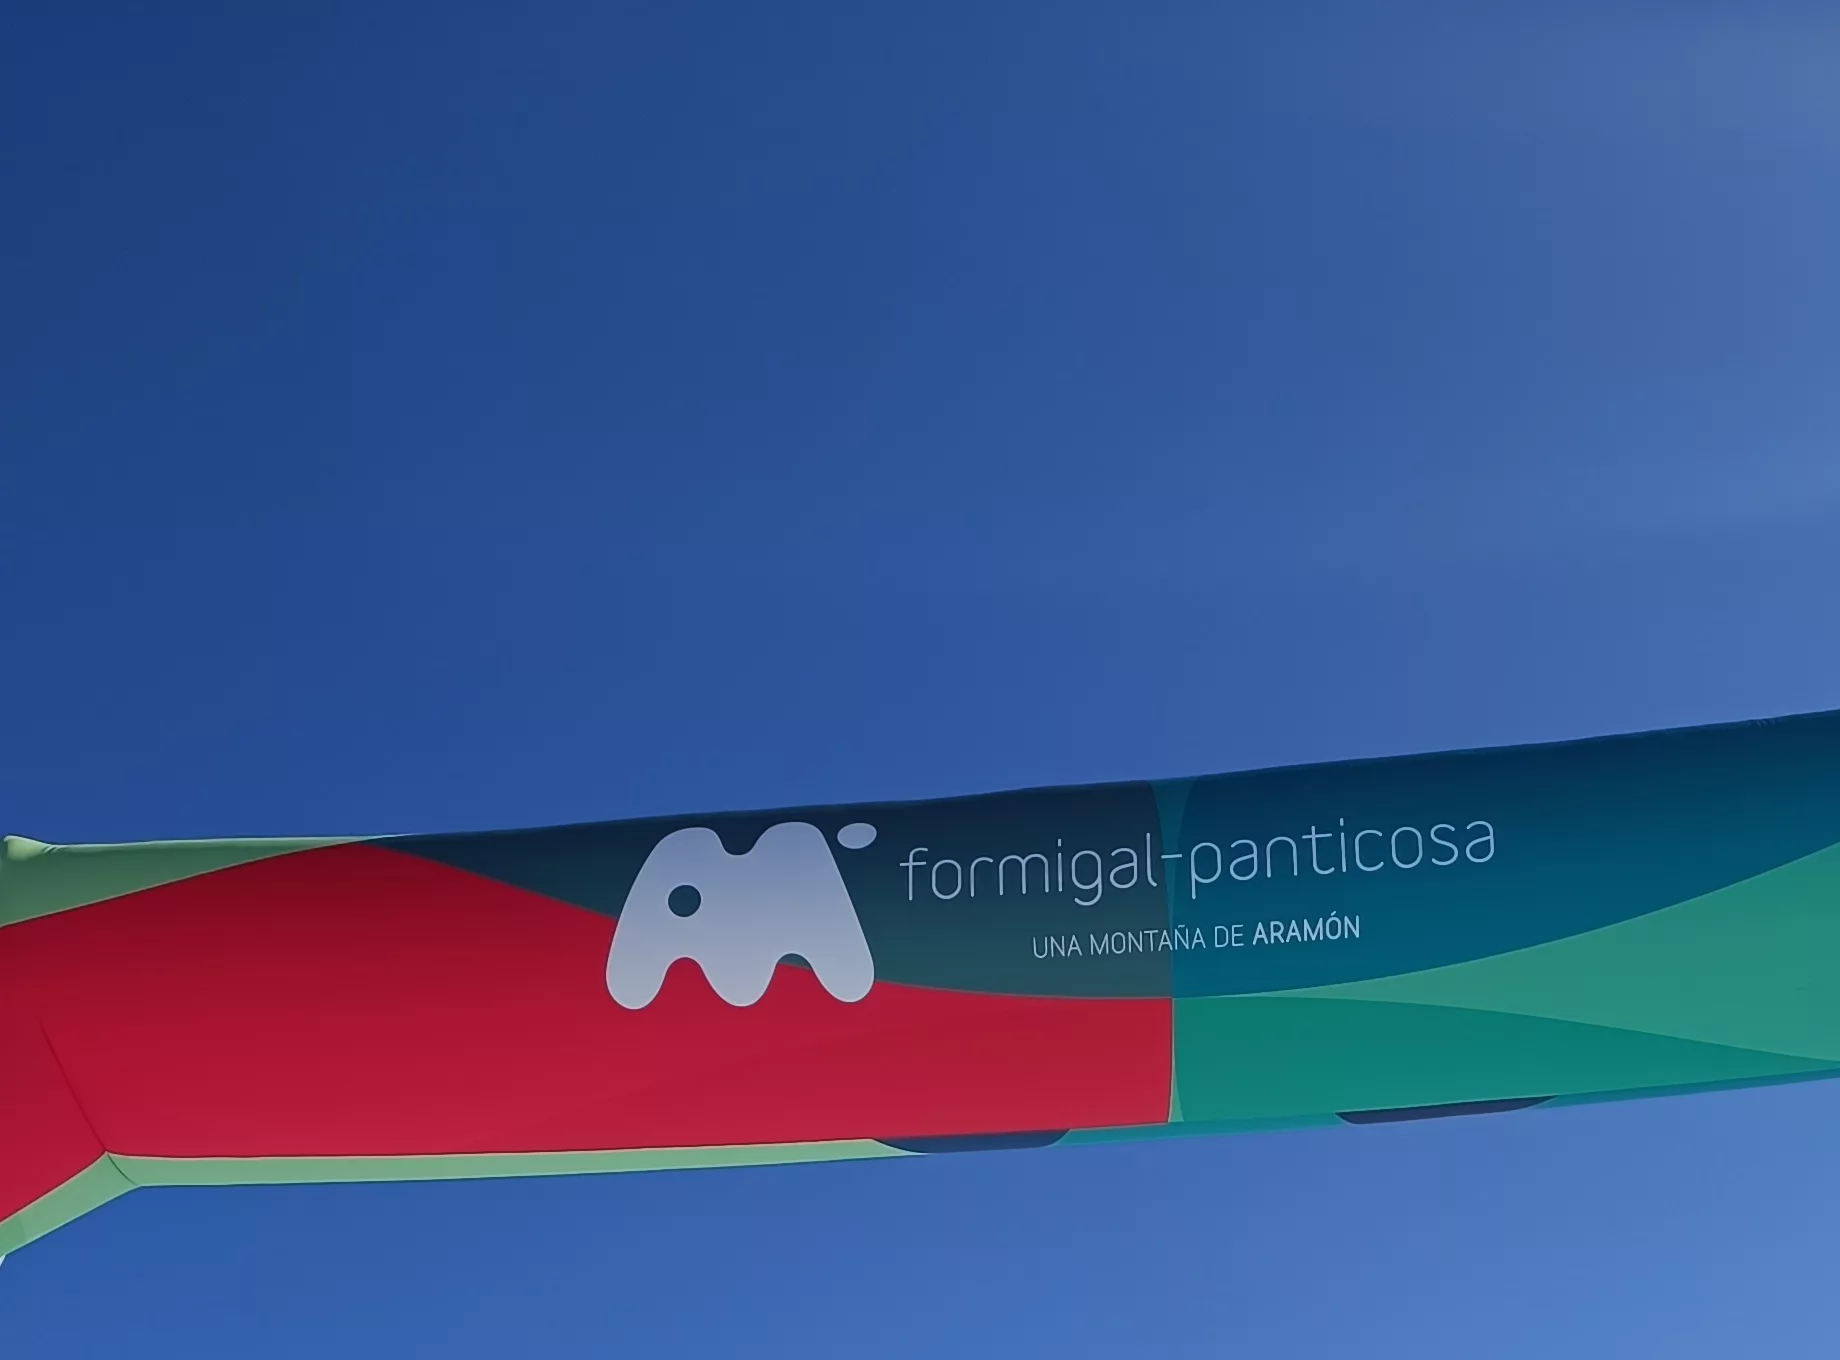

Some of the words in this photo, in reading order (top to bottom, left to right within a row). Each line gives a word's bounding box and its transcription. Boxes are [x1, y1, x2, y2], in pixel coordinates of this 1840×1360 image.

[900, 817, 1495, 906] formigal-panticosa
[1032, 934, 1083, 959] UNA
[1090, 924, 1206, 956] MONTAÑA
[1214, 924, 1245, 948] DE
[1252, 910, 1361, 946] ARAMÓN
